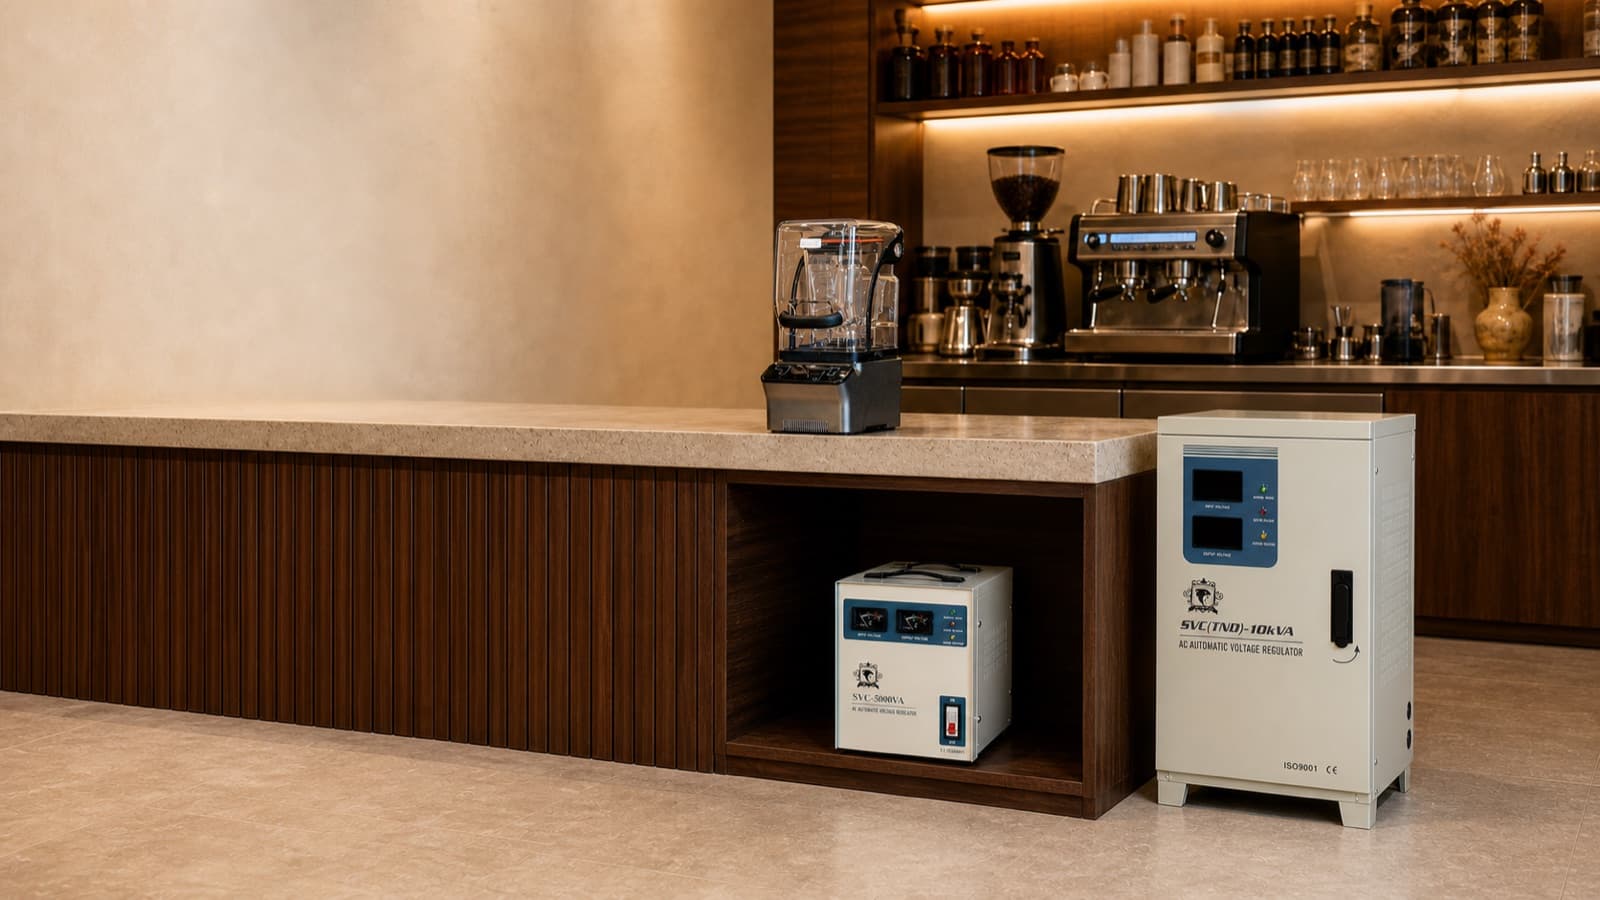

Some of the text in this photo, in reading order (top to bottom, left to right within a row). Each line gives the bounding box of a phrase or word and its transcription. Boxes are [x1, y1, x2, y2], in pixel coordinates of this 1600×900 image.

[1180, 620, 1294, 637] SVC(TND)-10kVA
[1179, 640, 1303, 657] AC AUTOMATIC VOLTAGE REGULATOR
[852, 693, 904, 704] SVC-5000VA
[1283, 762, 1317, 772] ISO9001
